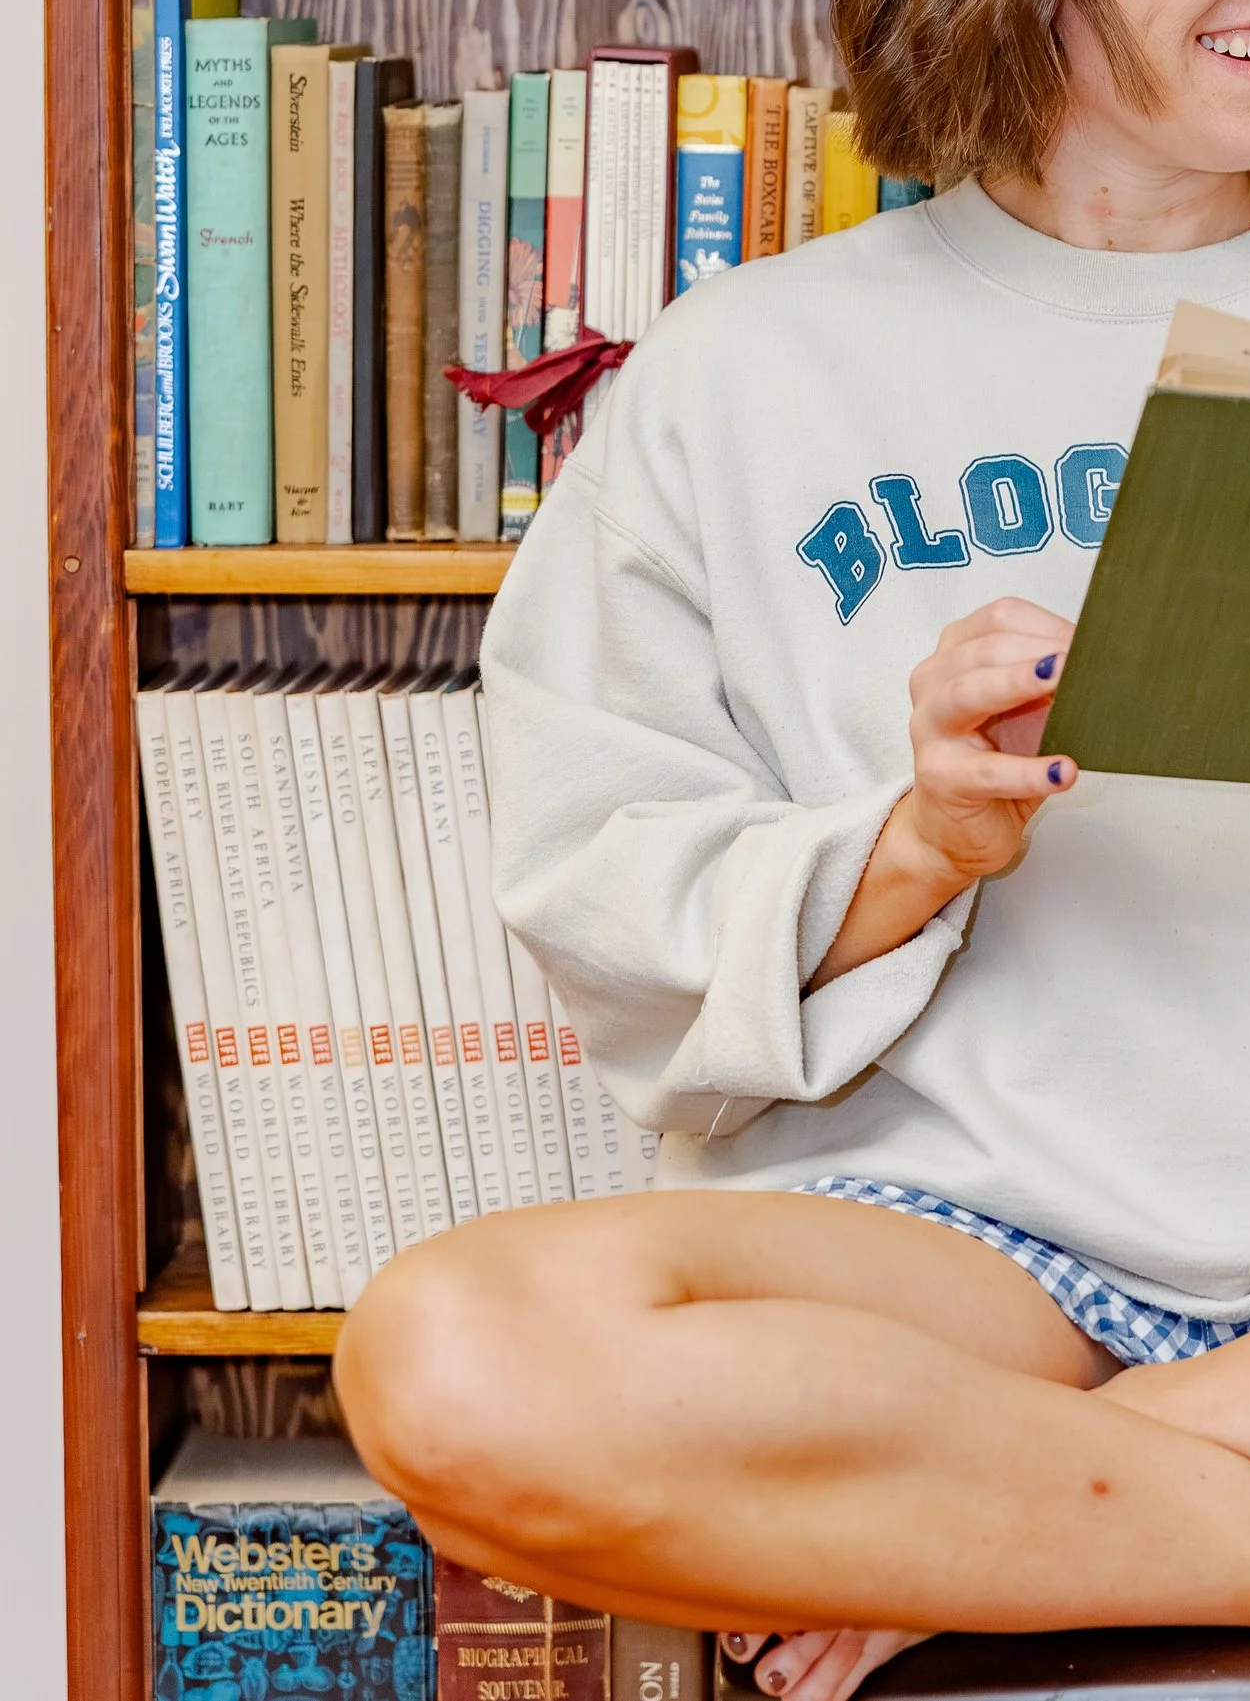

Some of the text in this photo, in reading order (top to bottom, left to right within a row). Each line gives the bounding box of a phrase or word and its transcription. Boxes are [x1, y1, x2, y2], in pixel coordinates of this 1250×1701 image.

[160, 36, 174, 71] PRESS
[195, 58, 252, 73] MYTHS
[213, 79, 233, 87] AND
[160, 72, 174, 139] DELACORTE
[189, 95, 261, 110] LEGENDS
[205, 132, 249, 147] AGES
[208, 116, 239, 125] OF THE
[803, 101, 819, 173] CAPTIVE
[700, 175, 721, 189] The
[759, 104, 781, 245] THE BOXCAR
[802, 179, 817, 203] OF
[200, 228, 255, 248] French
[288, 72, 309, 398] Silverstein Where the Sidewalk Ends
[477, 201, 492, 287] DIGGING
[683, 227, 734, 242] Robinson
[688, 210, 730, 226] Family
[333, 225, 349, 339] MYTHOLOGY
[158, 301, 175, 370] BROOKS
[158, 394, 175, 492] SCHULBERG
[209, 501, 245, 512] HART
[178, 735, 203, 821] TURKEY
[299, 737, 323, 822] RUSSIA
[330, 734, 356, 824] MEXICO
[358, 733, 383, 801] JAPAN
[393, 736, 416, 797] ITALY
[423, 731, 452, 845] GERMANY
[456, 730, 482, 820] GREECE
[151, 732, 188, 931] TROPICAL AFRICA
[237, 732, 275, 910] SOUTH AFRICA
[269, 734, 304, 894] SCANDINAVIA
[210, 735, 260, 1008] THE RIVER PLATE REPUBLICS
[351, 1077, 376, 1160] WORLD
[369, 1024, 406, 1158] LIFE WORLD
[186, 1021, 235, 1265] LIFE WORLD LIBRARY
[215, 1027, 267, 1270] LIFE WORLD LIBRARY
[248, 1025, 297, 1269] LIFE WORLD LIBRARY
[277, 1024, 328, 1266] LIFE WORLD LIBRARY
[309, 1025, 362, 1268] LIFE WORLD LIBRARY
[175, 1593, 388, 1639] Dictionary
[176, 1572, 397, 1594] New Twentieth Century
